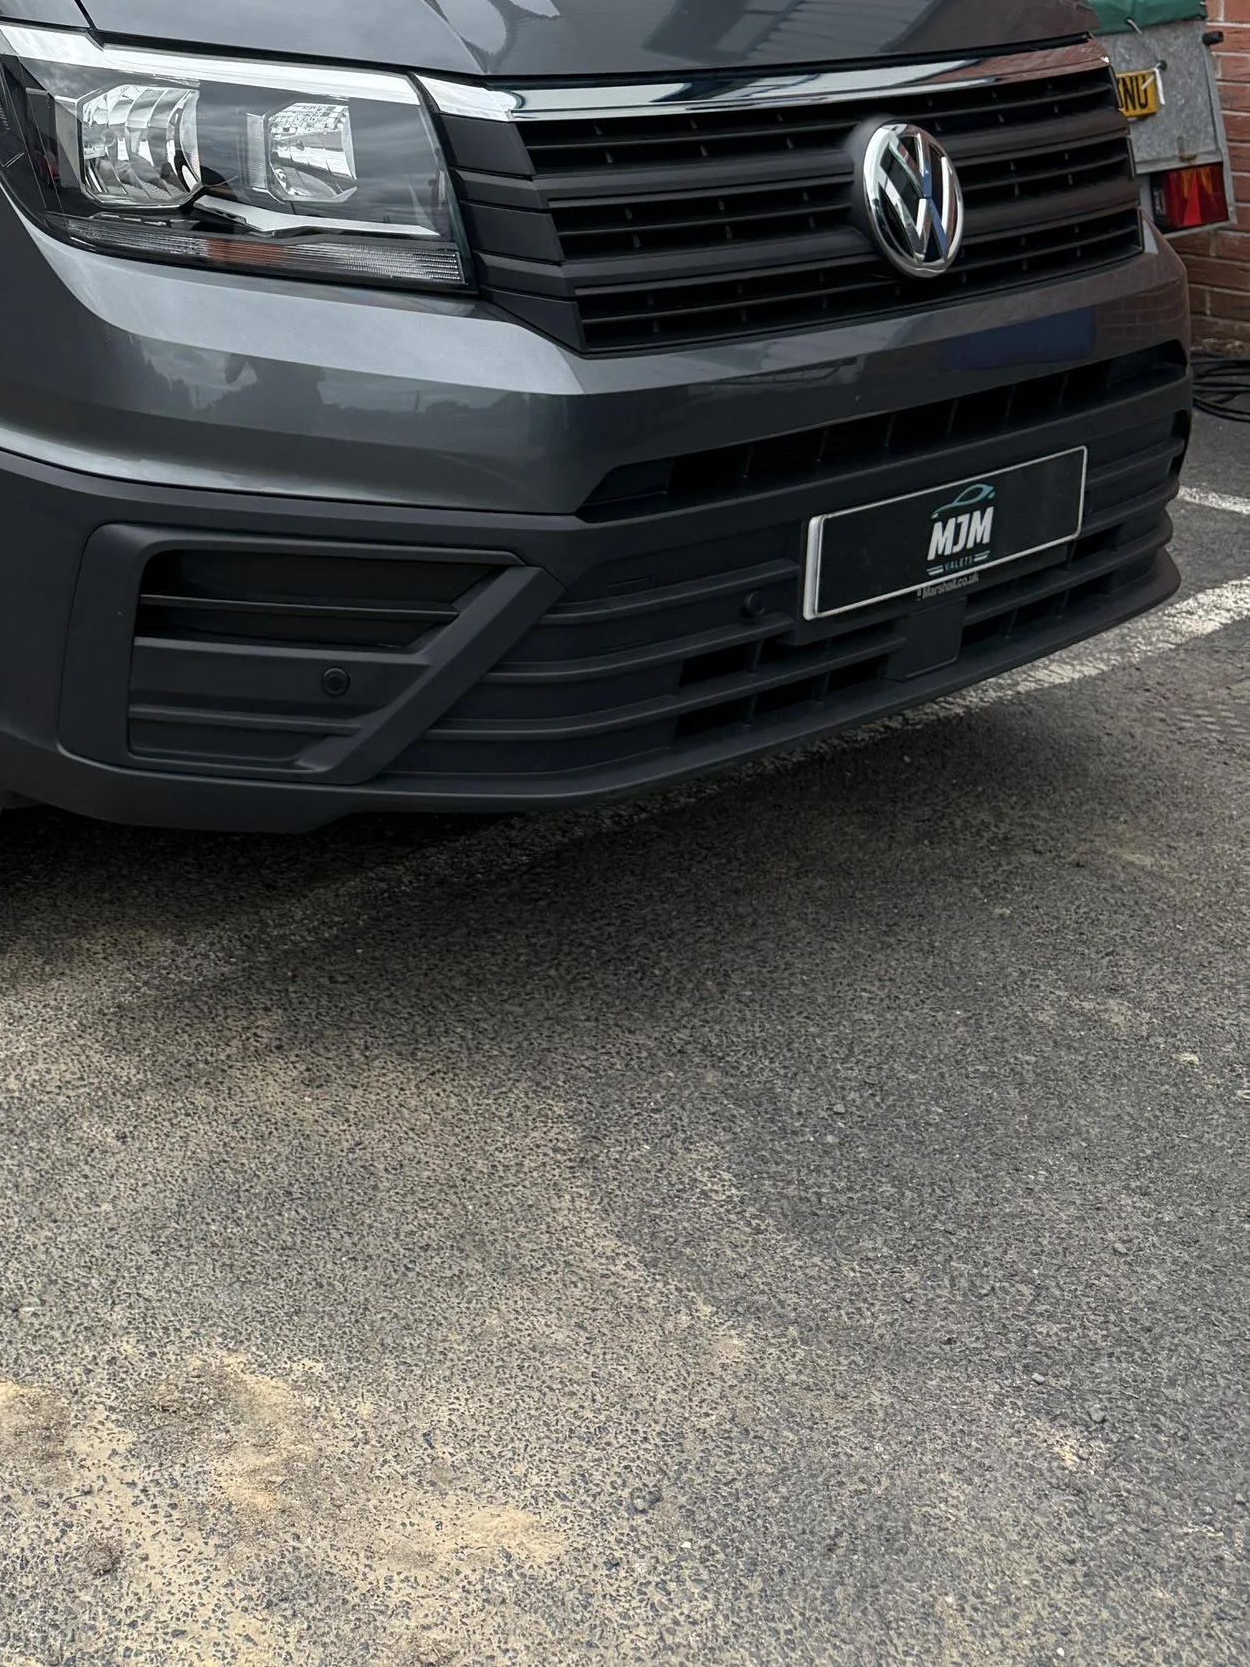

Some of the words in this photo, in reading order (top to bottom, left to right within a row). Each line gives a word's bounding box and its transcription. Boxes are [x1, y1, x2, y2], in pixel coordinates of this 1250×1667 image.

[1117, 73, 1149, 112] NU
[927, 506, 994, 561] MJM
[943, 555, 974, 571] VALETS
